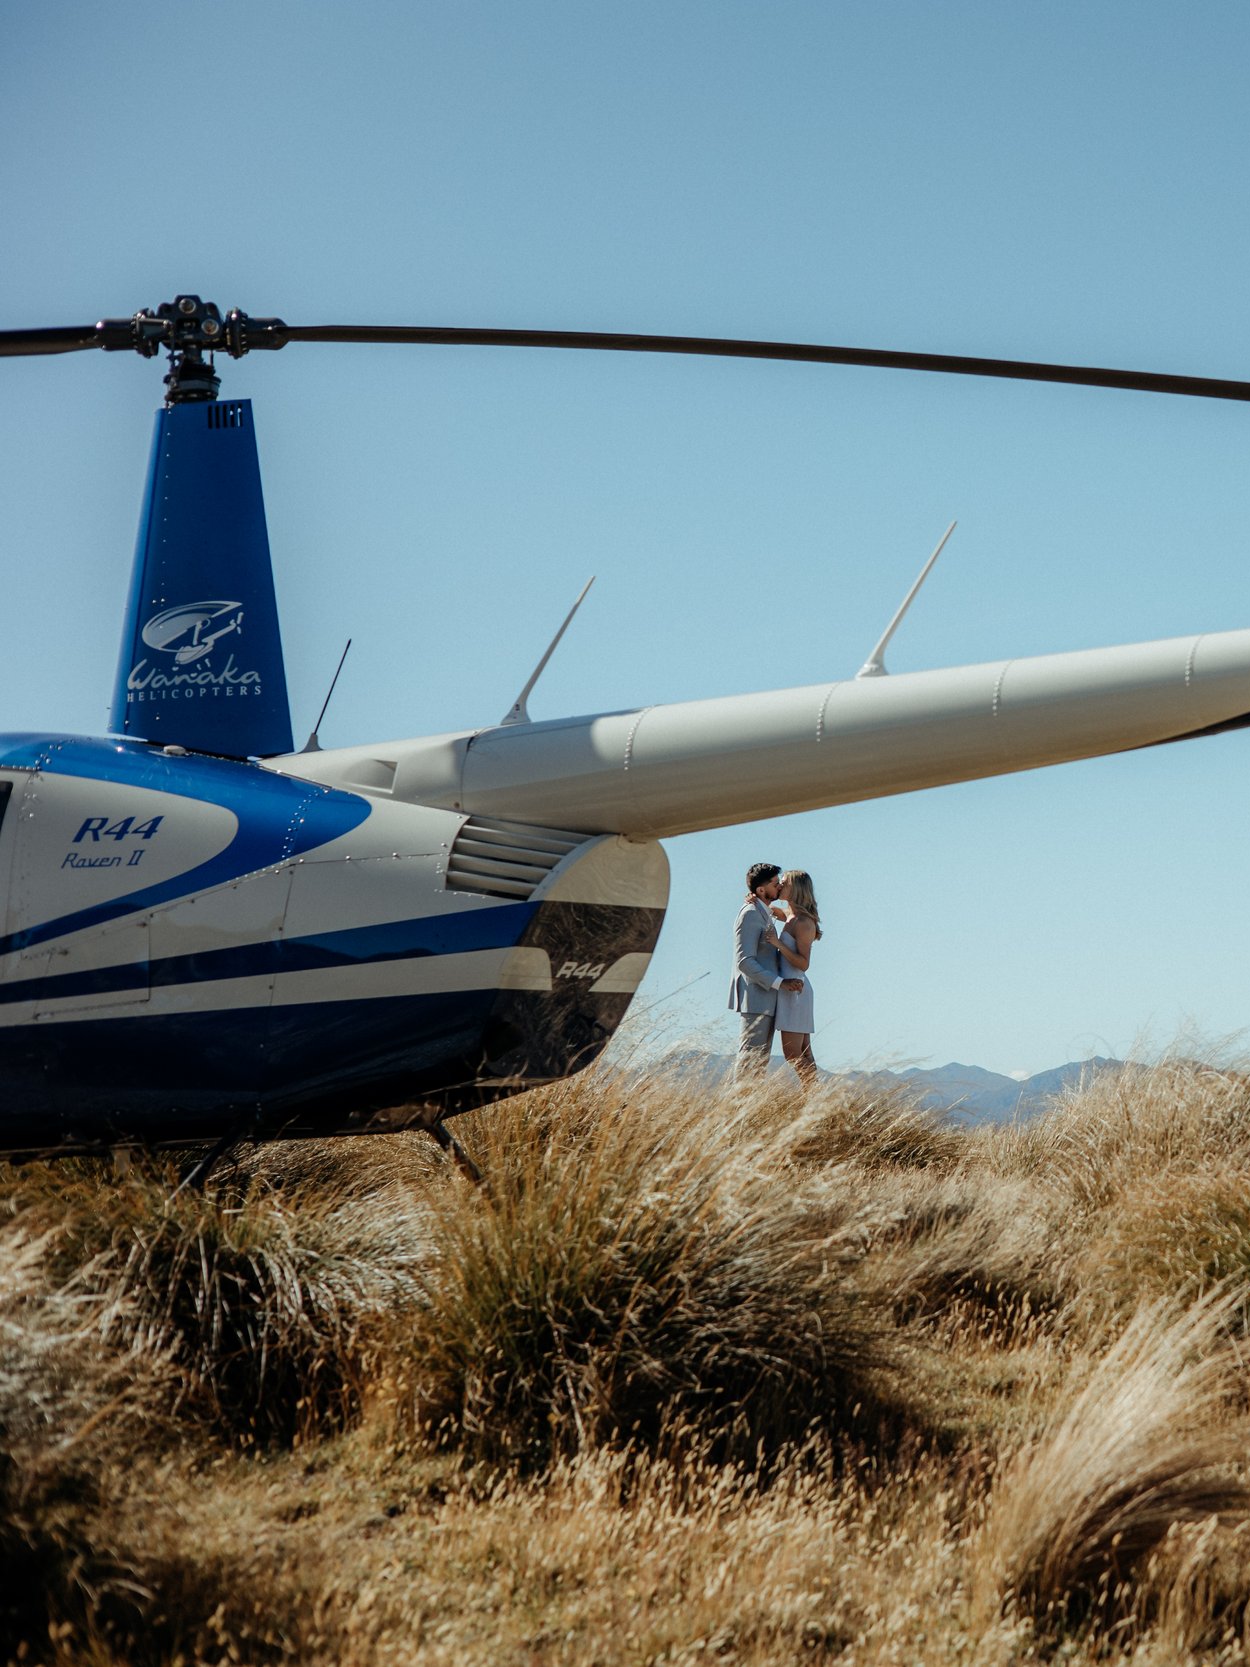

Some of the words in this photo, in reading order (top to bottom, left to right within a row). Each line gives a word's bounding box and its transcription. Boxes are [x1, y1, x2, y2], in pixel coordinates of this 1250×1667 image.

[127, 653, 262, 690] Wanaka
[127, 685, 262, 703] HELICOPTERS
[72, 815, 165, 843] R44
[61, 852, 122, 869] Raven
[126, 849, 146, 866] II
[555, 961, 606, 980] R44
